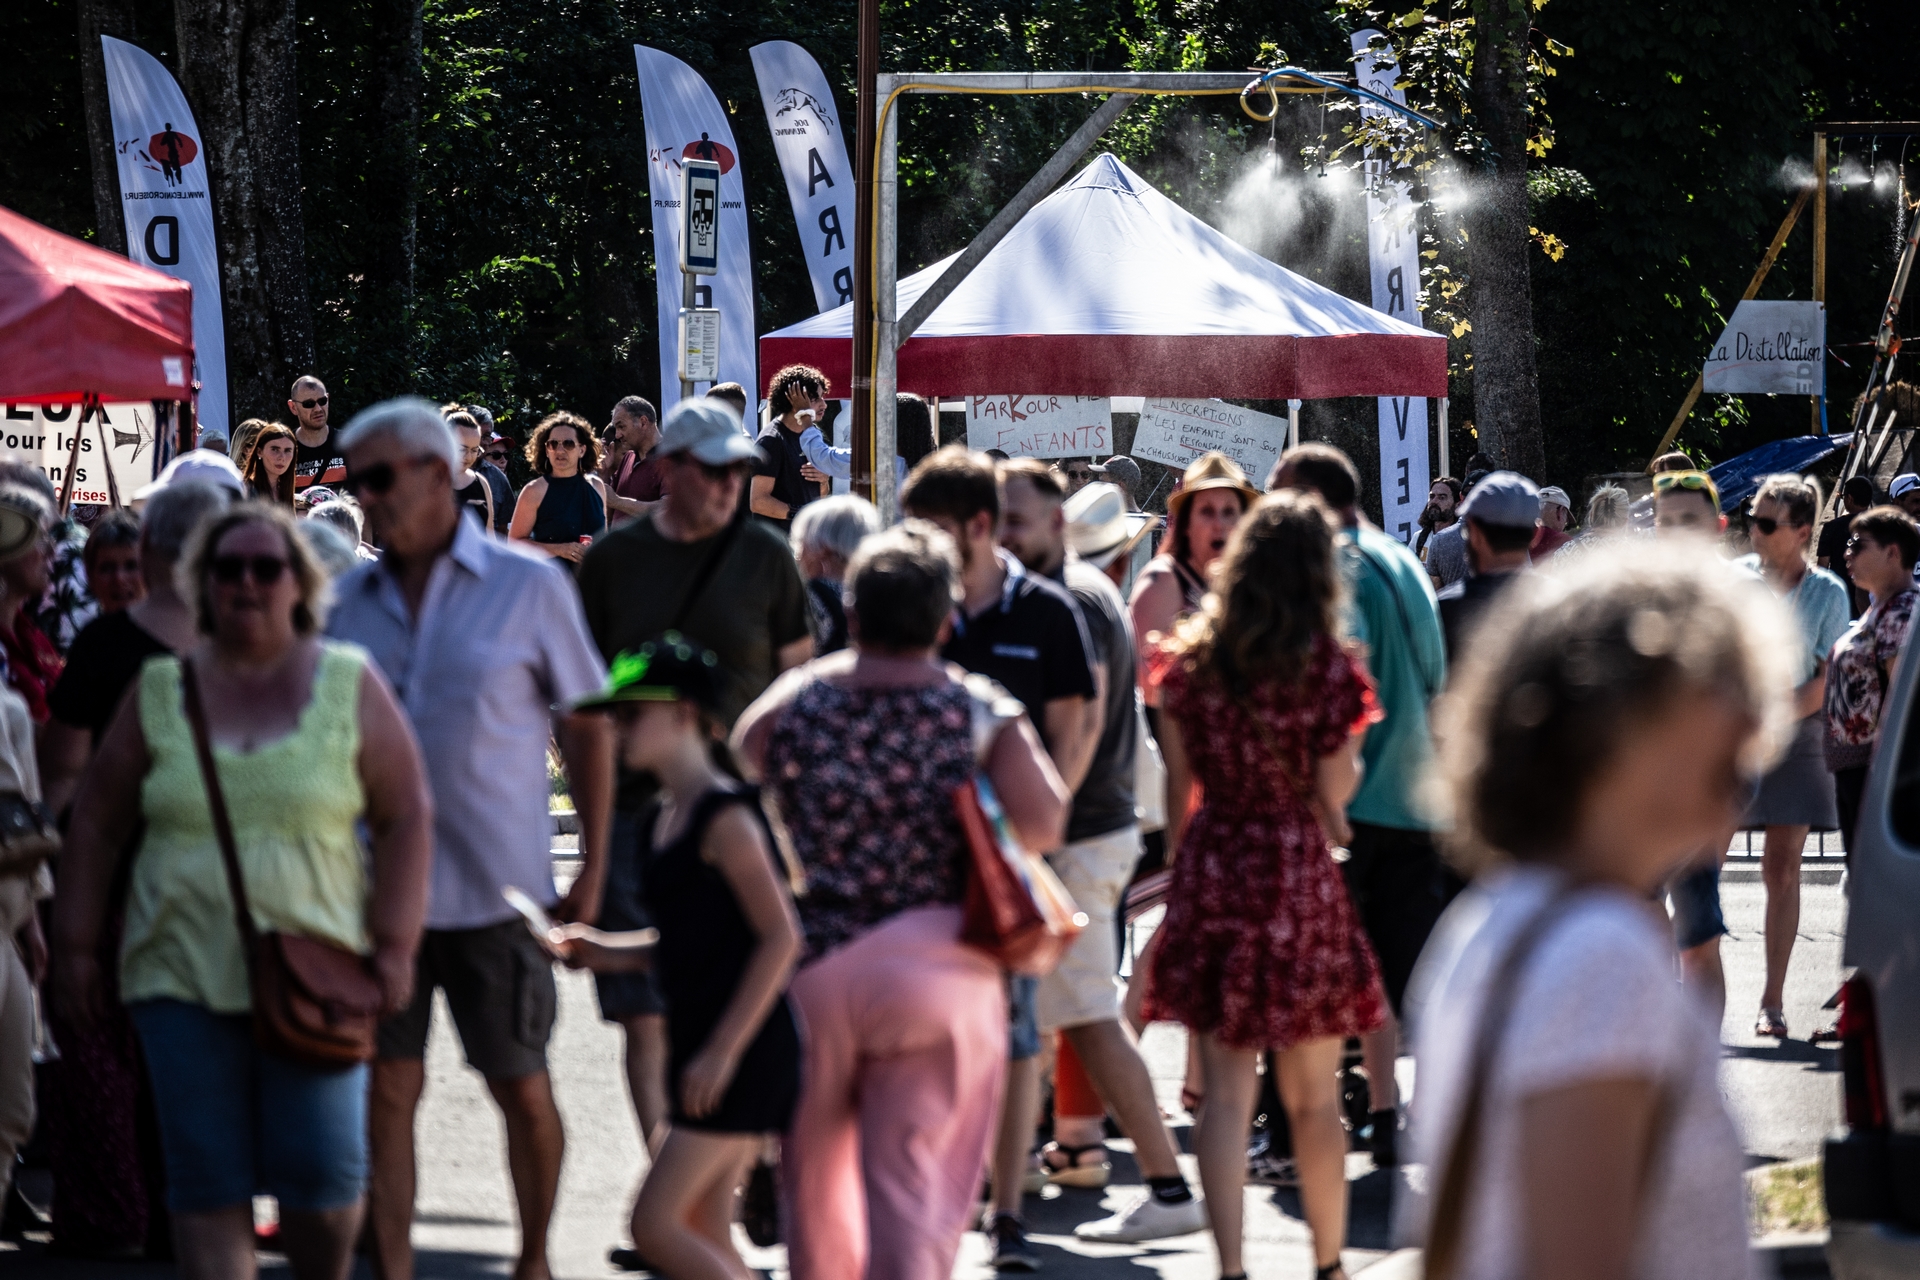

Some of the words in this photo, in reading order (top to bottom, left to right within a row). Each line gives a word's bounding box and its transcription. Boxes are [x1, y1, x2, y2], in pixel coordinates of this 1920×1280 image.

[1736, 331, 1822, 362] Distillation
[1155, 414, 1177, 431] LES
[1182, 424, 1226, 440] ENFANTS
[1163, 432, 1174, 442] LA
[57, 432, 92, 453] les
[54, 487, 107, 502] Crises
